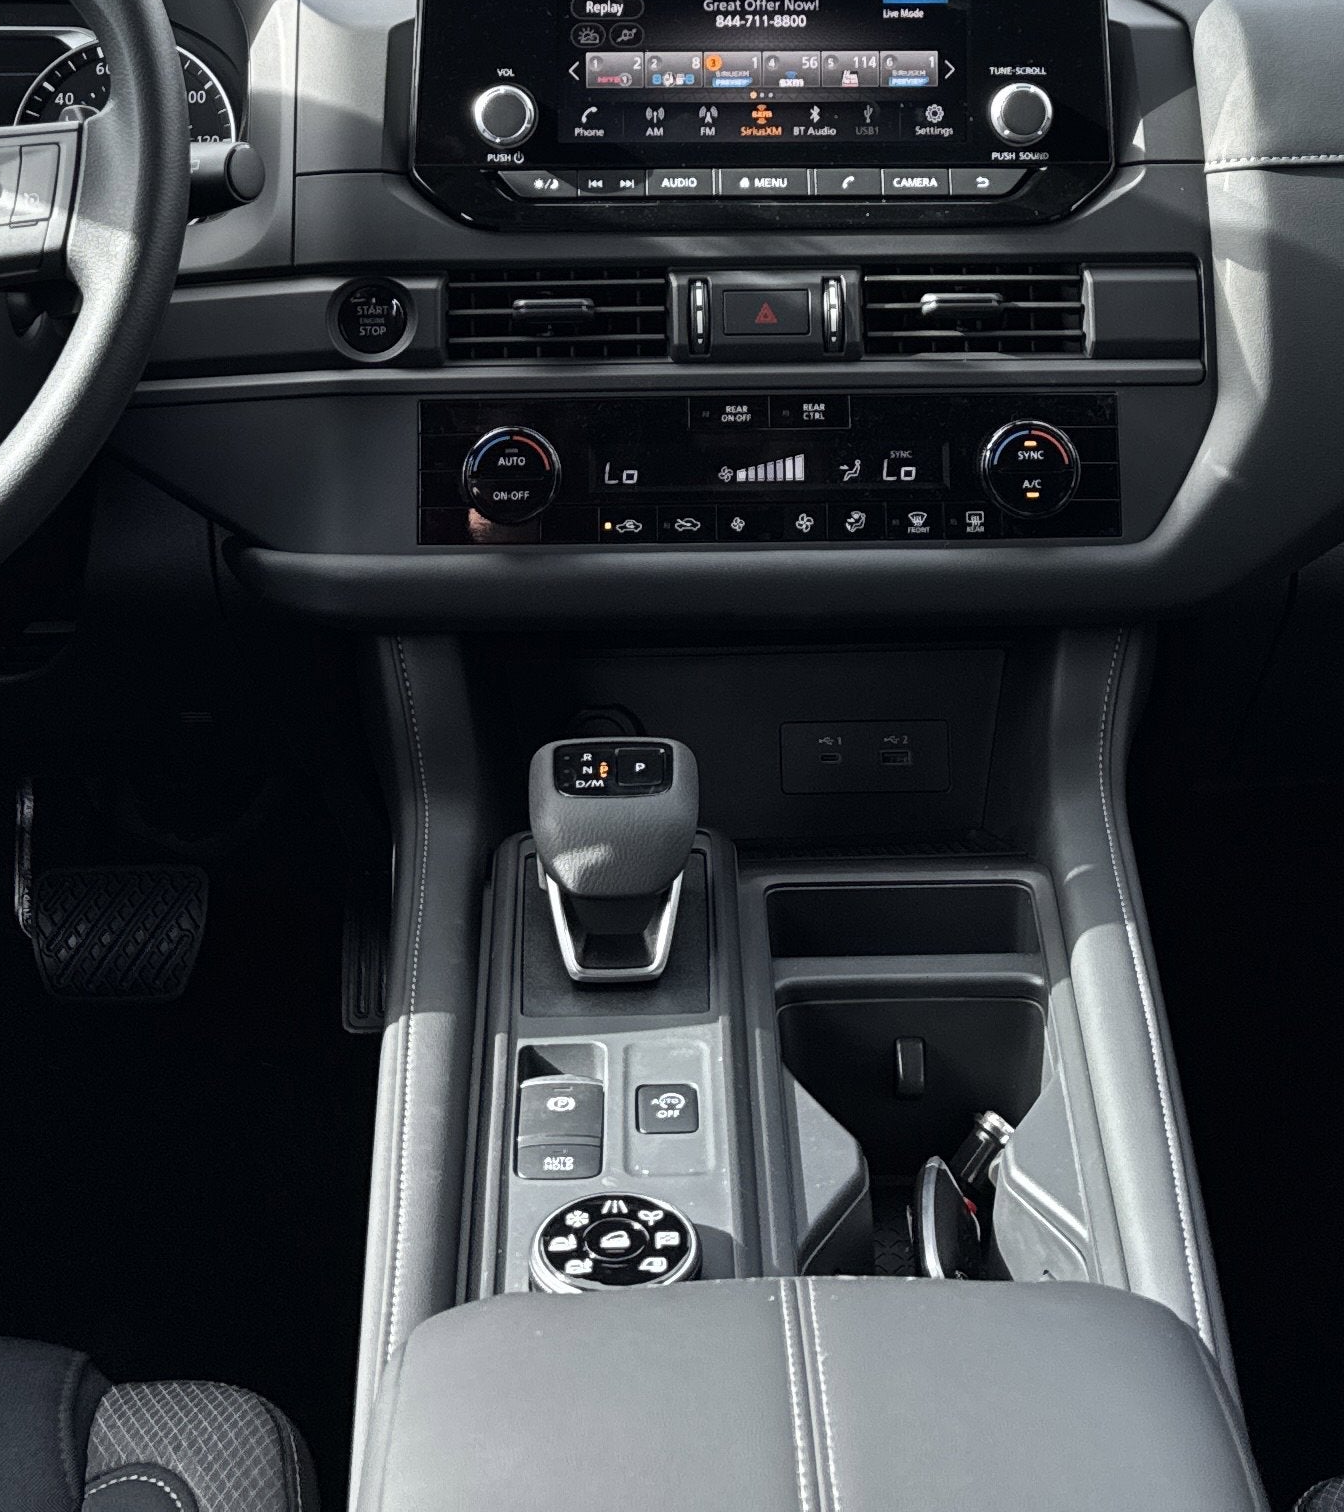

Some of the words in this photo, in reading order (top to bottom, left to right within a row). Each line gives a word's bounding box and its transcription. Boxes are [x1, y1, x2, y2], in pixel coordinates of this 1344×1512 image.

[585, 1, 624, 16] Replay
[703, 0, 741, 12] Great
[784, 0, 820, 12] Now!
[883, 9, 898, 19] Live
[900, 9, 924, 19] Mode
[715, 15, 807, 28] 844-711-8800
[633, 58, 641, 70] 2
[691, 57, 701, 69] 8
[751, 58, 758, 69] 1
[802, 56, 818, 68] 56
[854, 56, 876, 68] 114
[928, 56, 935, 68] 1
[497, 68, 515, 77] VOL
[55, 92, 74, 104] 40
[188, 90, 206, 104] 00
[574, 127, 605, 136] Phone
[646, 127, 663, 136] AM
[700, 127, 715, 136] FM
[741, 126, 782, 136] SiriusXM
[793, 126, 805, 135] BT
[807, 126, 837, 136] Audio
[915, 125, 953, 137] Settings
[487, 153, 511, 162] PUSH
[991, 151, 1015, 160] PUSH
[1019, 151, 1049, 160] SOUND
[661, 177, 697, 188] AUDIO
[754, 177, 788, 188] MENU
[893, 177, 938, 188] CAMERA
[357, 305, 388, 316] START
[359, 326, 387, 336] STOP
[725, 404, 748, 414] REAR
[802, 403, 826, 412] REAR
[803, 412, 825, 420] CTRL
[890, 450, 913, 459] SYNC
[1017, 450, 1045, 461] SYNC
[497, 456, 526, 466] AUTO
[605, 462, 638, 484] Lo
[882, 459, 916, 481] Lo
[1022, 479, 1042, 489] A/C
[583, 753, 592, 761] R
[582, 766, 593, 774] N
[635, 763, 646, 772] P
[576, 779, 605, 788] D/M
[656, 1109, 680, 1118] OFF
[544, 1156, 574, 1164] AUTO
[543, 1163, 574, 1171] HOLD
